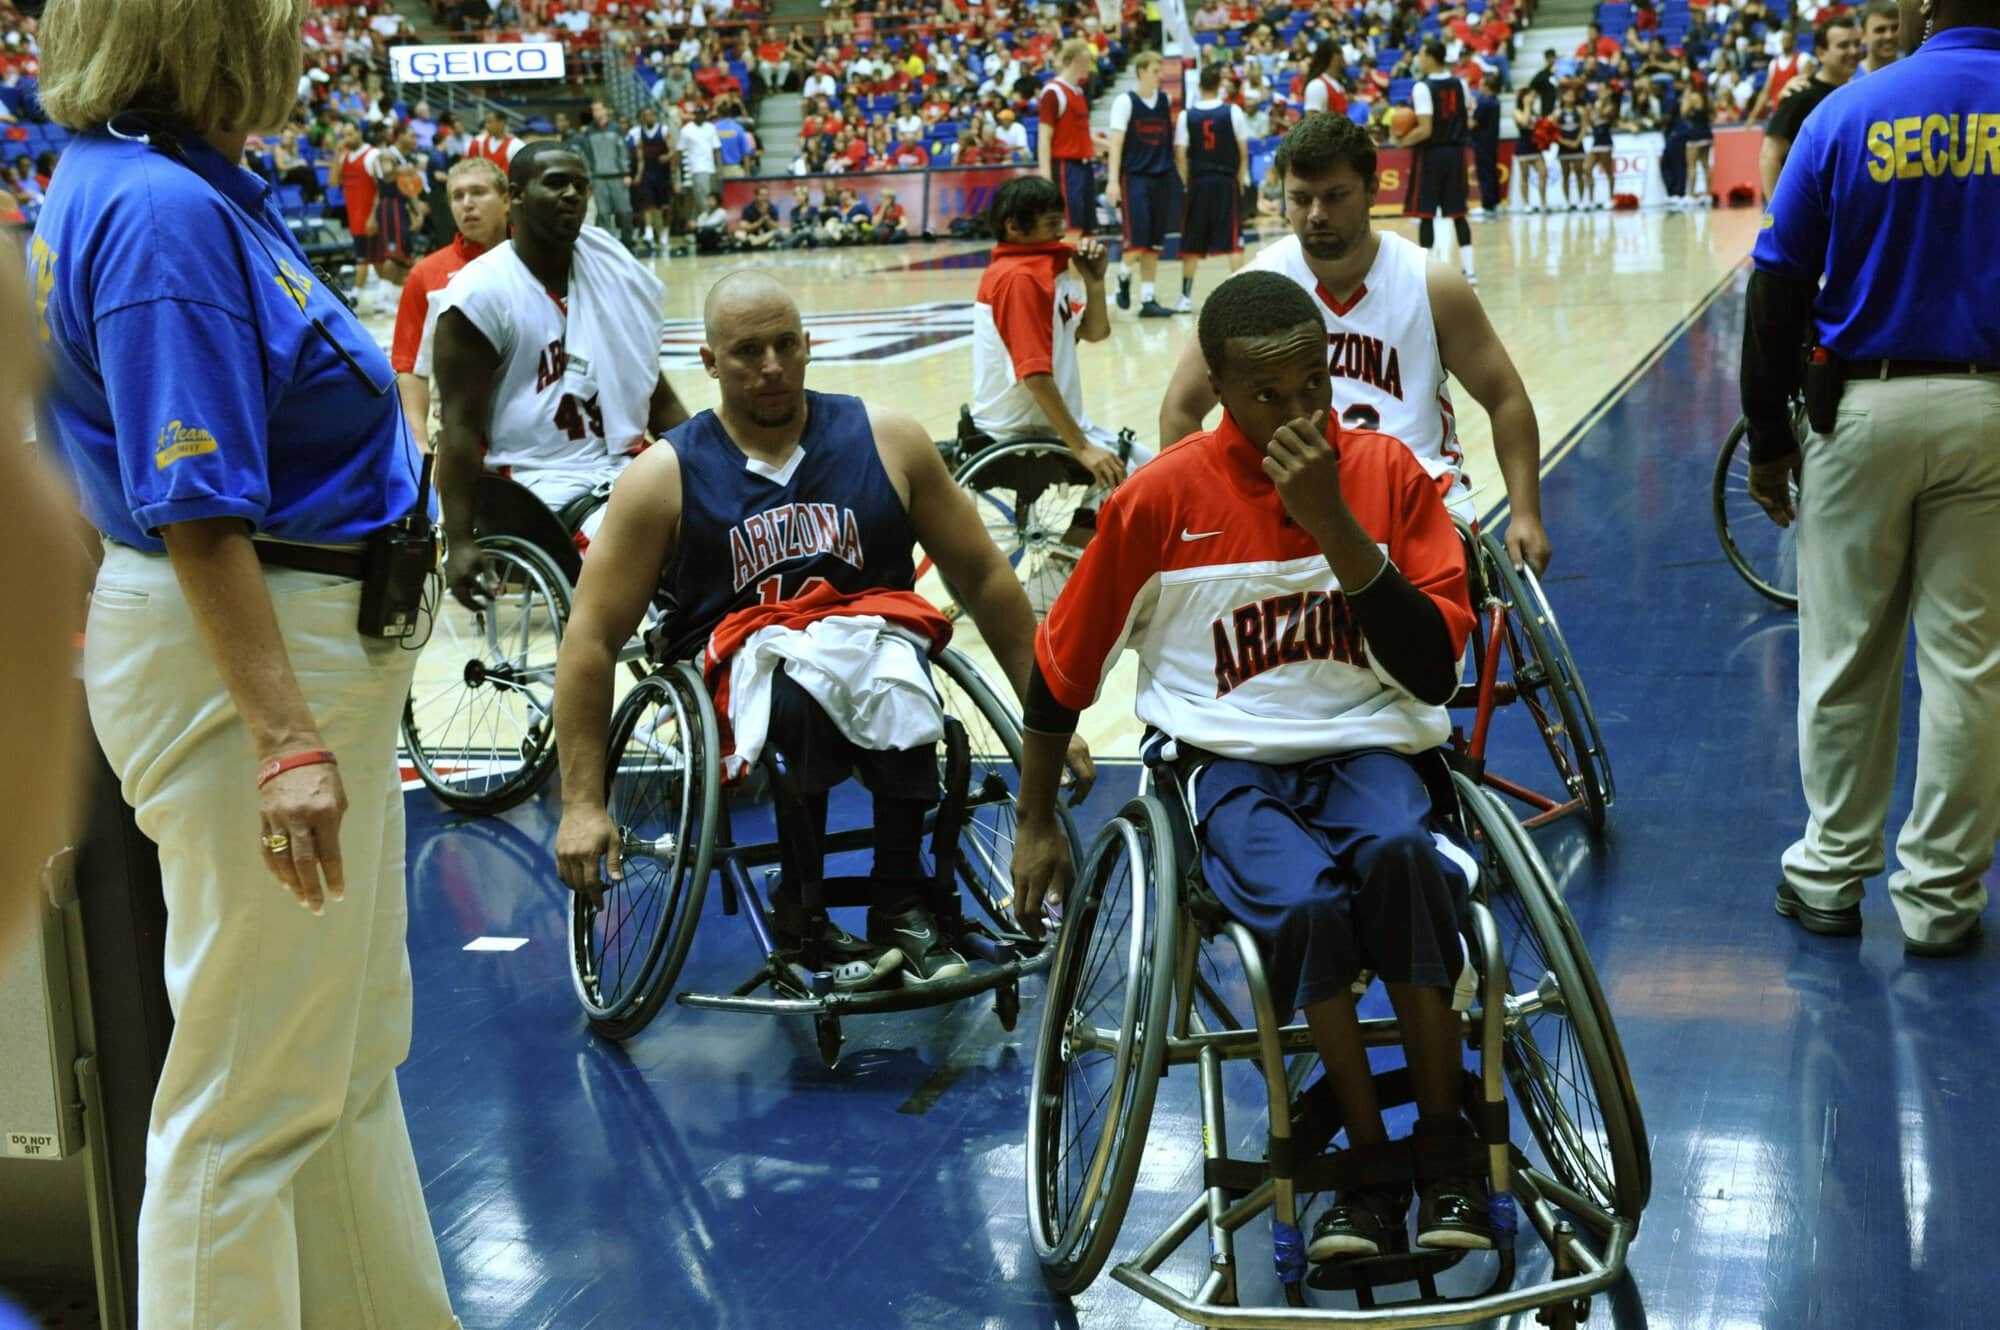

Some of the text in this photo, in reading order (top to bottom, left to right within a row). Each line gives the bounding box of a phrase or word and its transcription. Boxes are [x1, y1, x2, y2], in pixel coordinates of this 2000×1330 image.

[409, 48, 548, 77] GEICO
[1866, 112, 2000, 184] SECUR
[1327, 332, 1404, 402] ZONA
[729, 502, 865, 594] ARIZONA
[1212, 589, 1371, 700] ARIZON
[11, 1135, 52, 1146] DO NOT
[24, 1144, 41, 1155] SIT
